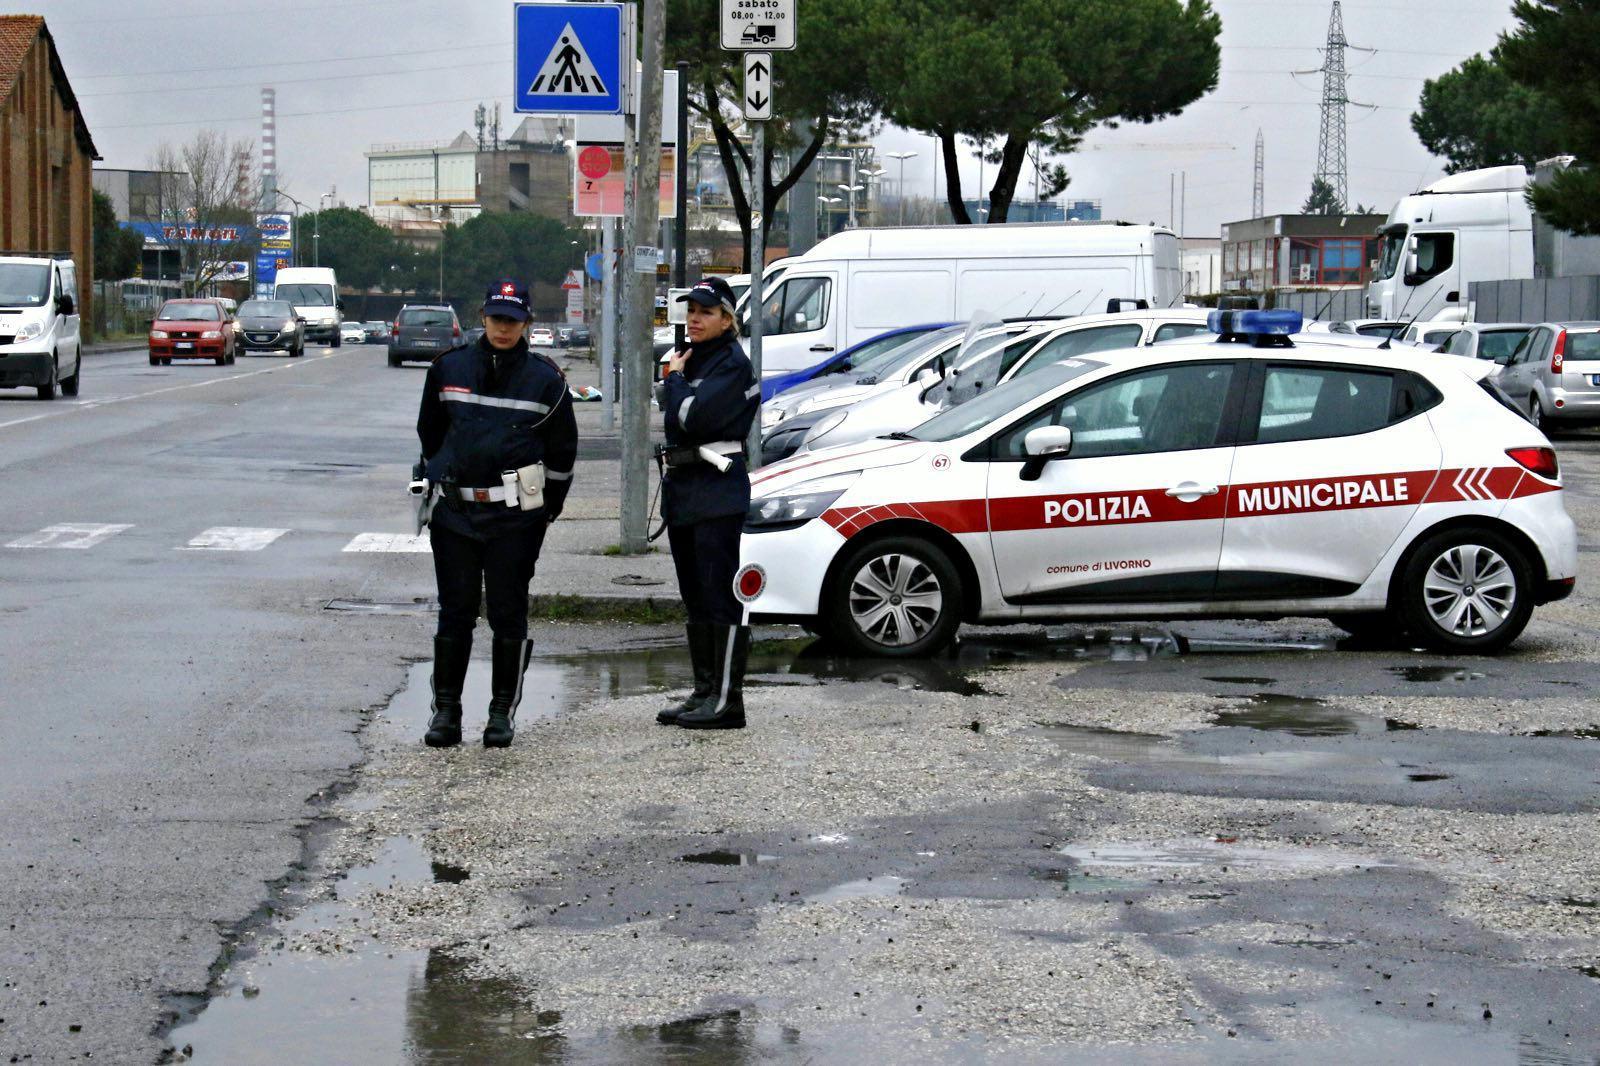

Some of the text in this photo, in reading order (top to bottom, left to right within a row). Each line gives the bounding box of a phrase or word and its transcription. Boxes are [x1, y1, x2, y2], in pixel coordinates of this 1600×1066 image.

[738, 0, 779, 8] sabato
[731, 11, 754, 19] 08.00
[765, 11, 785, 19] 12.00
[585, 181, 593, 190] 7
[162, 226, 240, 240] TAMOIL
[934, 459, 947, 467] 67
[1043, 477, 1408, 524] POLIZIA MUNICIPALE
[1046, 559, 1151, 574] comune di LIVORNO
